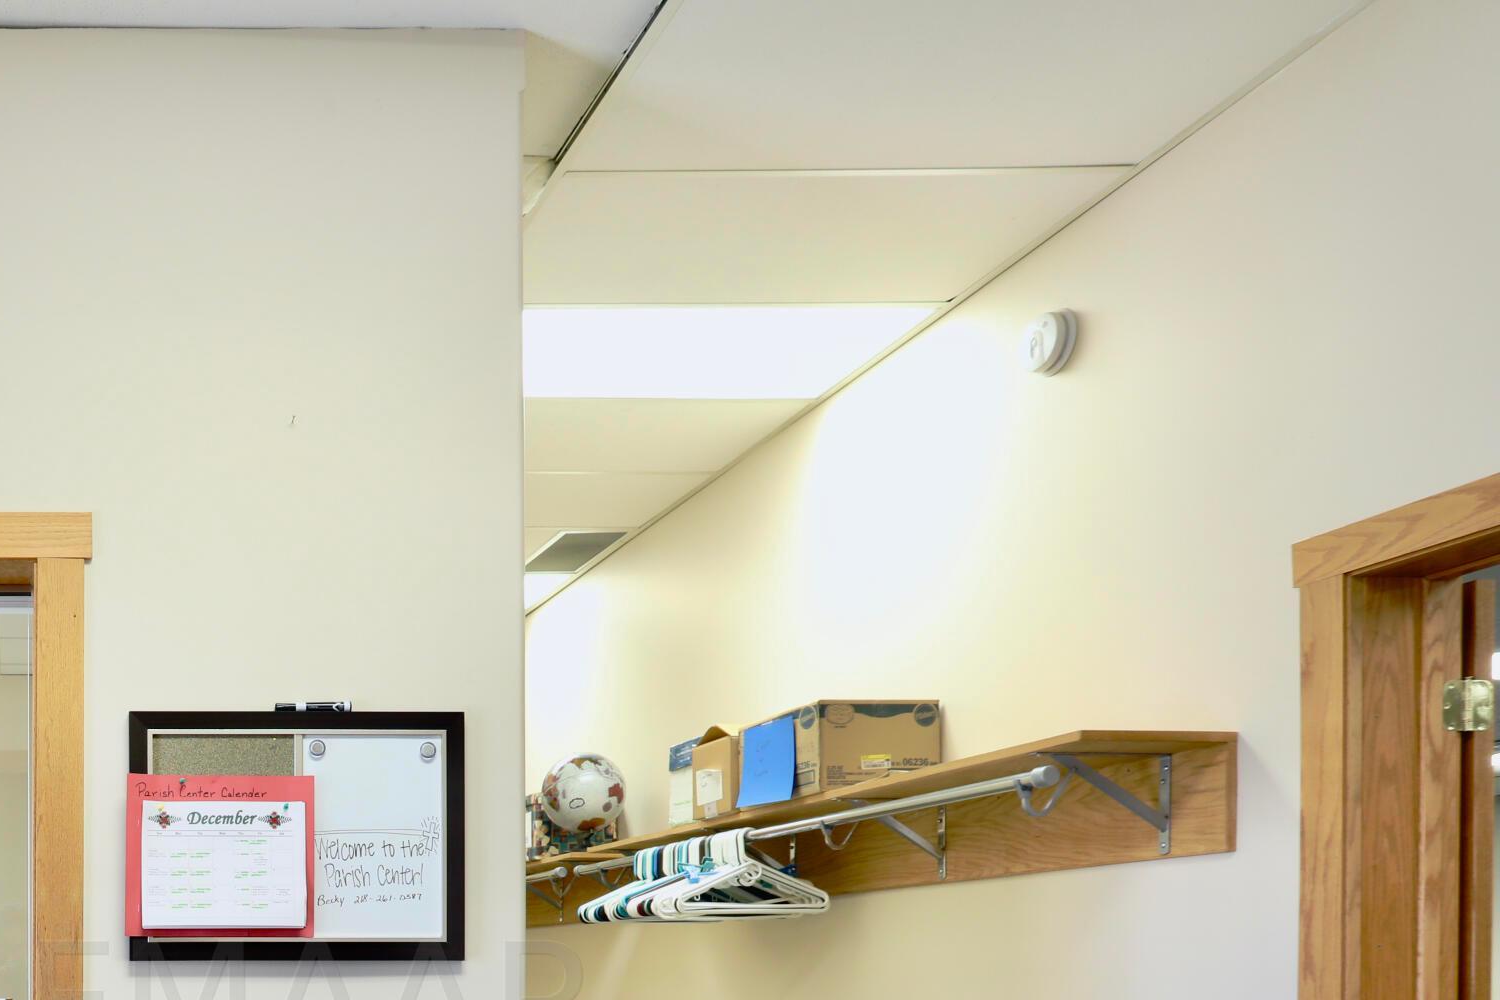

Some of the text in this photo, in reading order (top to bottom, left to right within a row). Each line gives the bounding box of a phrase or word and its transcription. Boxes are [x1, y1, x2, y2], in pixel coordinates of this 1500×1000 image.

[135, 781, 268, 799] Parish Center Calender
[186, 810, 258, 826] December
[314, 836, 425, 861] Welcome to the
[324, 862, 371, 888] Parish
